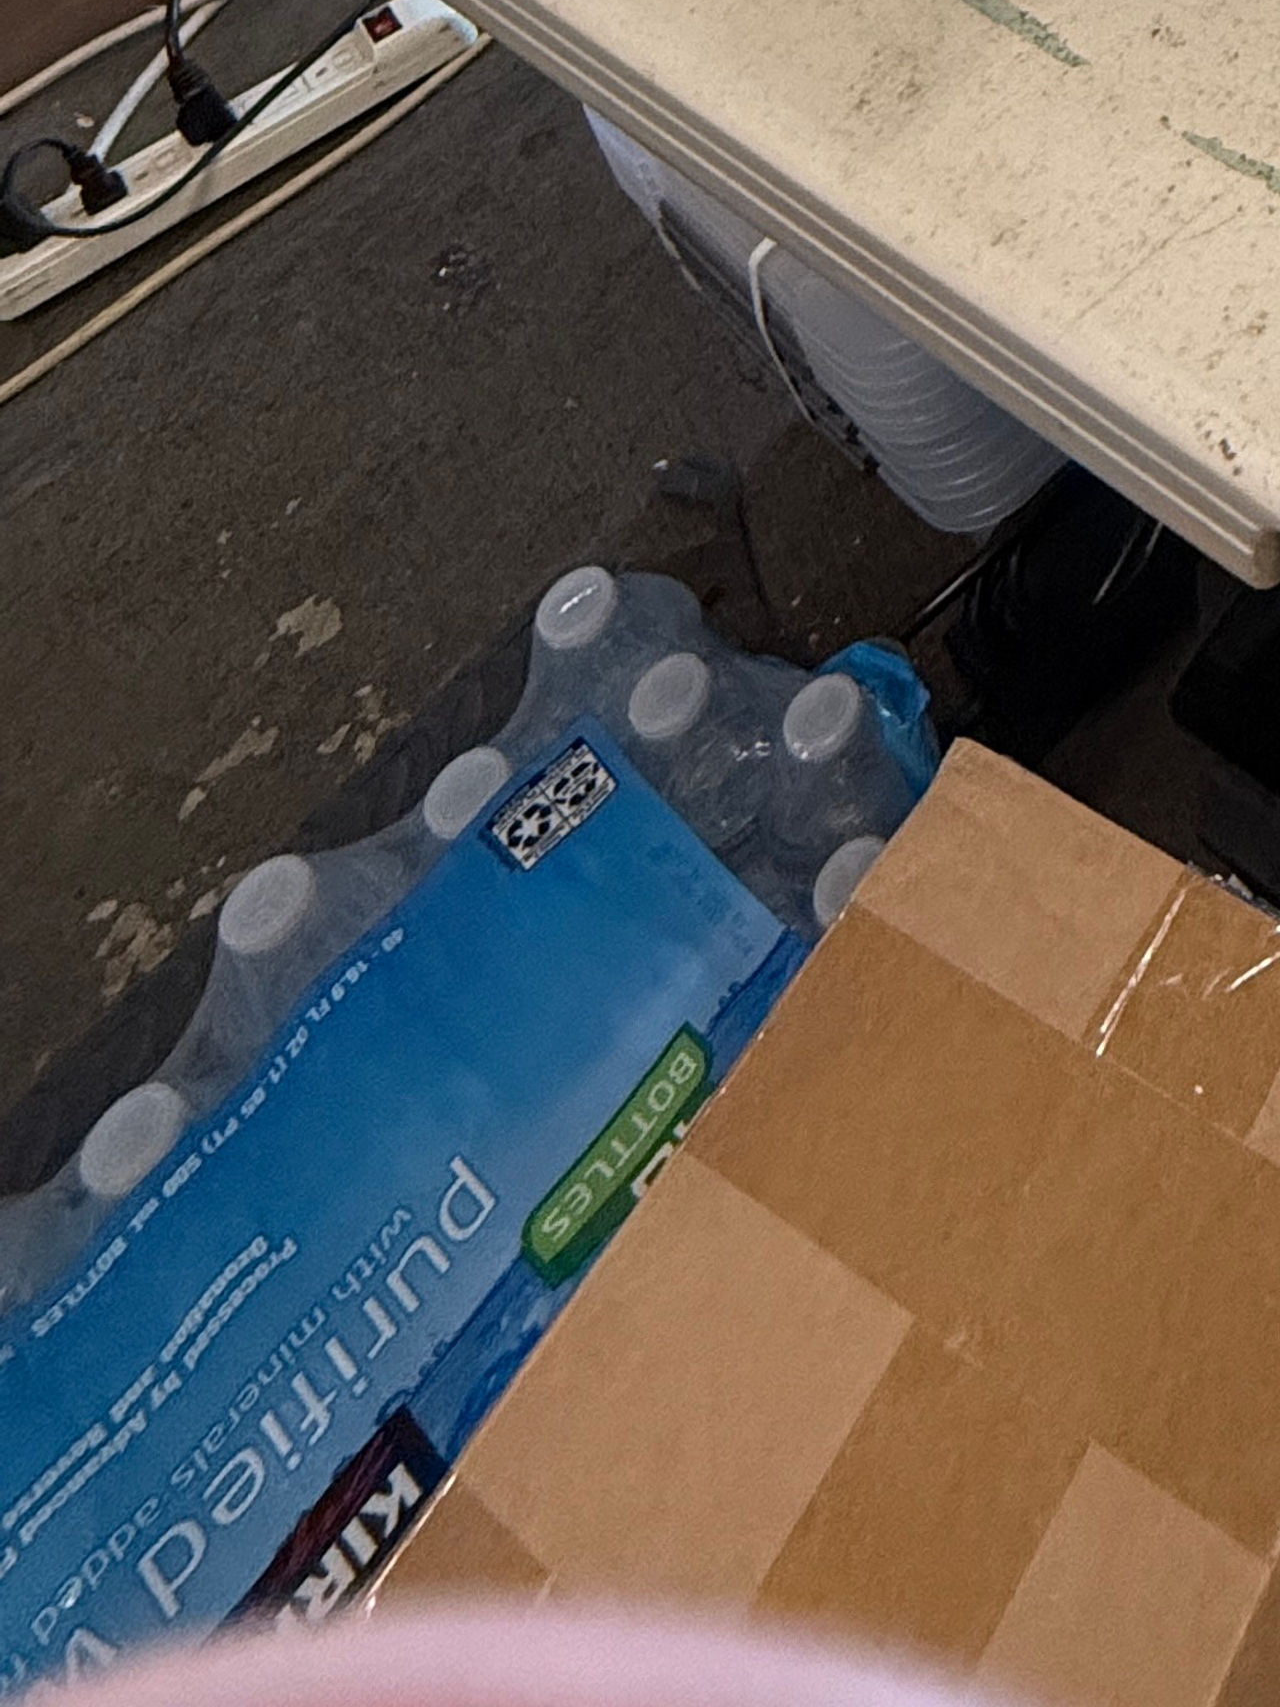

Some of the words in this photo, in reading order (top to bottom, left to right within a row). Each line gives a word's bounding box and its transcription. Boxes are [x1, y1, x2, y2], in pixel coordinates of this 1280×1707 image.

[541, 1051, 698, 1241] BOTTLES
[31, 1237, 129, 1338] BOTTLES
[160, 1235, 269, 1364] Ozonation
[183, 1237, 298, 1370] Processed
[331, 1208, 412, 1302] with
[109, 1364, 157, 1423] and
[136, 1155, 497, 1619] purified
[151, 1370, 184, 1410] by
[171, 1307, 326, 1488] minerals
[2, 1422, 109, 1530] Reverse
[20, 1410, 148, 1546] Advanced
[30, 1497, 162, 1646] added
[276, 1462, 421, 1630] KIR
